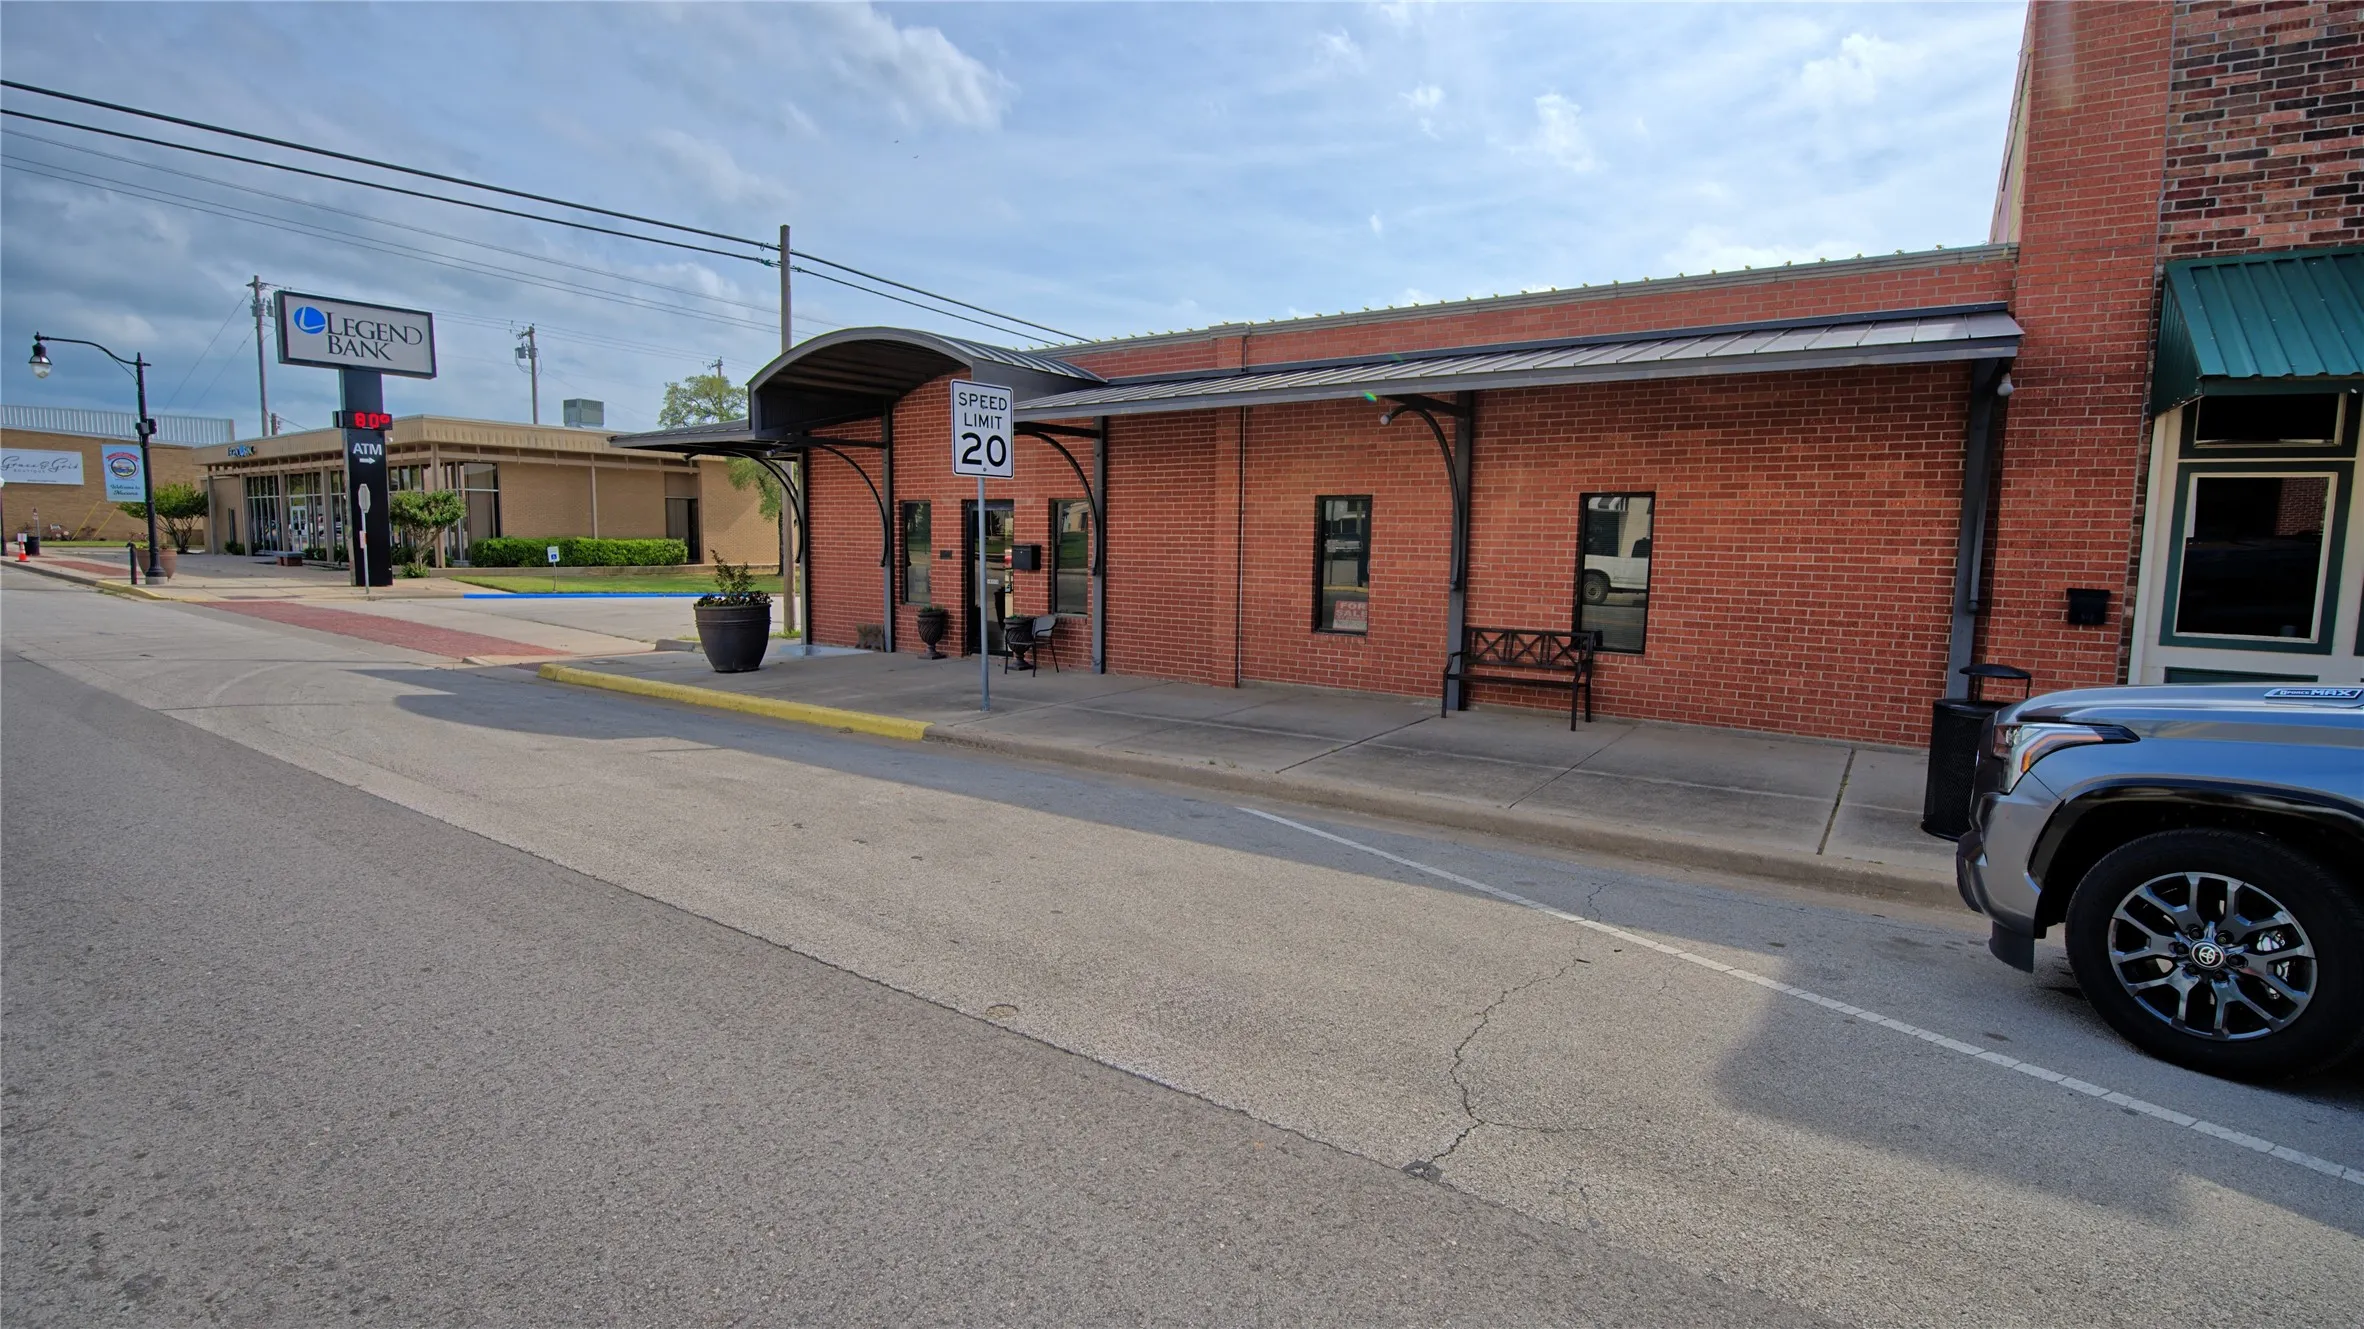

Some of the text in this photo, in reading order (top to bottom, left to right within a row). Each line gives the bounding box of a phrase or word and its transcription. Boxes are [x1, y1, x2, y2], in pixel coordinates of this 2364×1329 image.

[325, 311, 423, 345] LEGEND
[328, 335, 393, 361] BANK
[958, 392, 1007, 411] SPEED
[964, 412, 1002, 430] LIMIT
[353, 443, 382, 456] ATM
[961, 432, 1007, 467] 20
[1340, 602, 1366, 610] FOR
